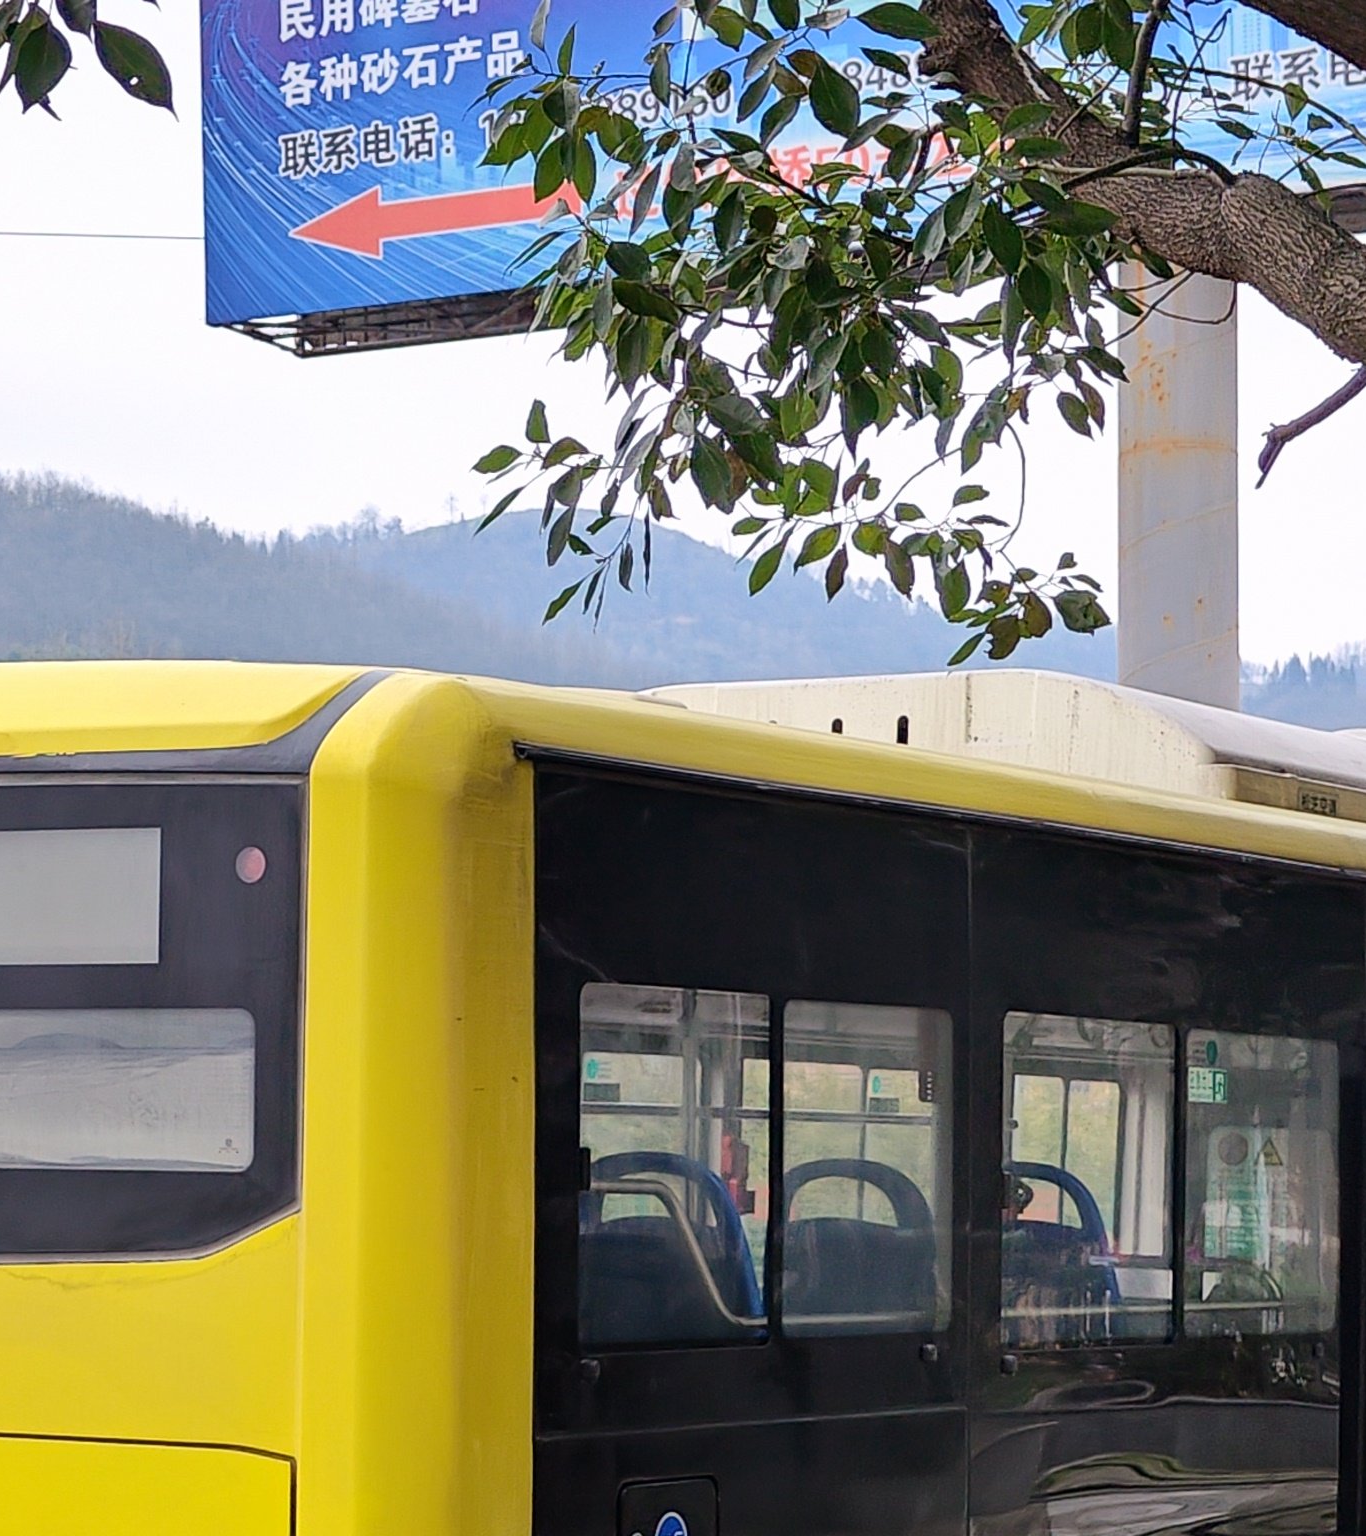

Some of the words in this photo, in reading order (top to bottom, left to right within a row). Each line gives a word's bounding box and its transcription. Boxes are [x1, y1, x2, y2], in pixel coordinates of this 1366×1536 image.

[279, 31, 524, 108] 各种砂石产品
